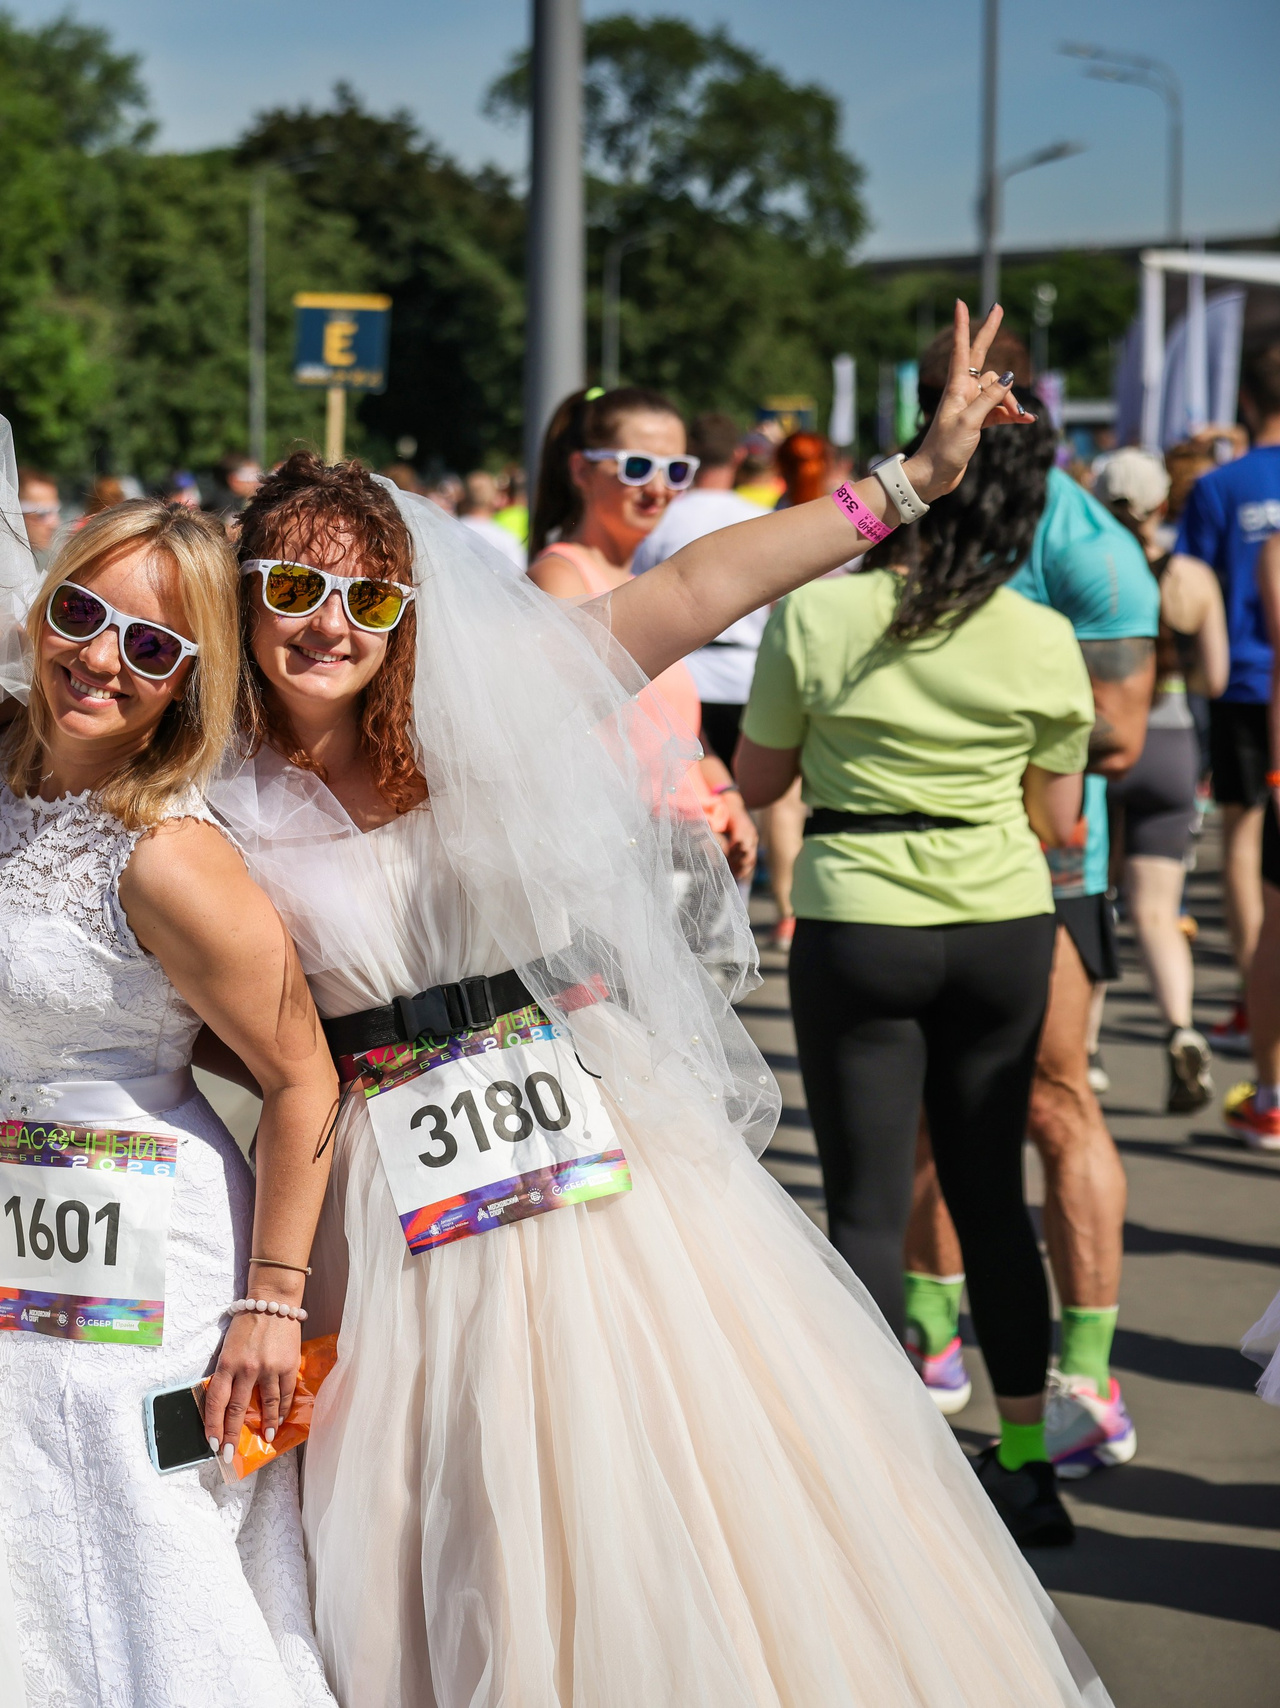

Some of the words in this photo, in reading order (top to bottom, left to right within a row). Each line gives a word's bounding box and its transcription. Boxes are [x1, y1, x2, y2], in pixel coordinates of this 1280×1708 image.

[383, 1046, 471, 1089] ЗАБЕГ
[410, 1071, 571, 1168] 3180
[72, 1155, 170, 1177] 2026
[4, 1195, 121, 1267] 1601
[87, 1319, 111, 1327] СБЕР
